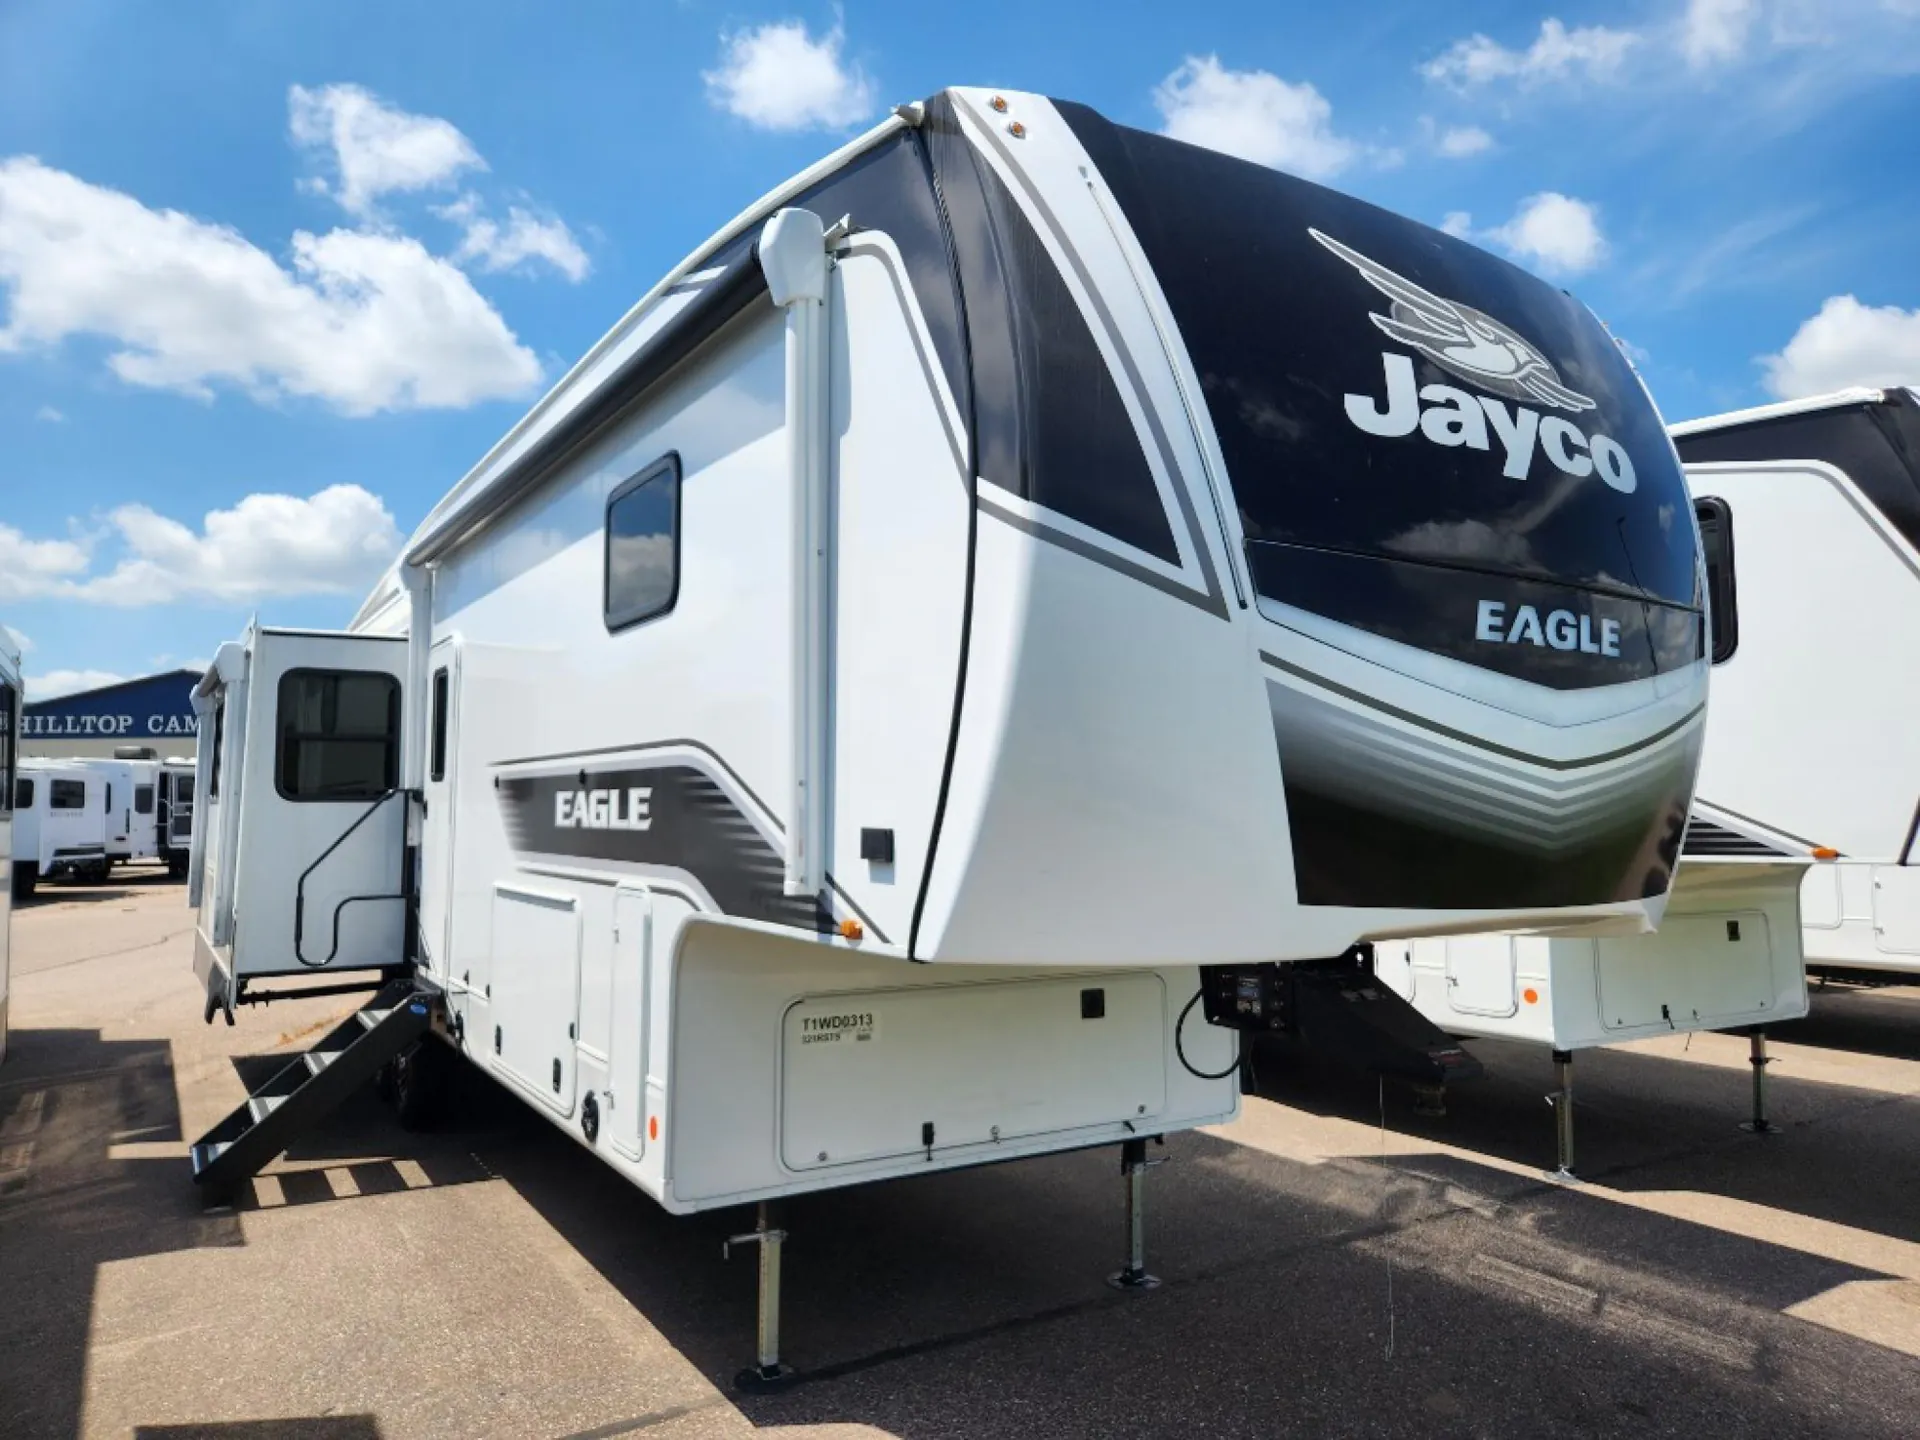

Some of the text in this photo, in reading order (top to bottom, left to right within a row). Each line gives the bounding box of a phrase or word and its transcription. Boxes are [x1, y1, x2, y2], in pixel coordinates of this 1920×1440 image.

[1344, 352, 1637, 494] Jayco
[1475, 599, 1621, 658] EAGLE
[20, 715, 133, 734] HILLTOP
[555, 787, 653, 831] EAGLE
